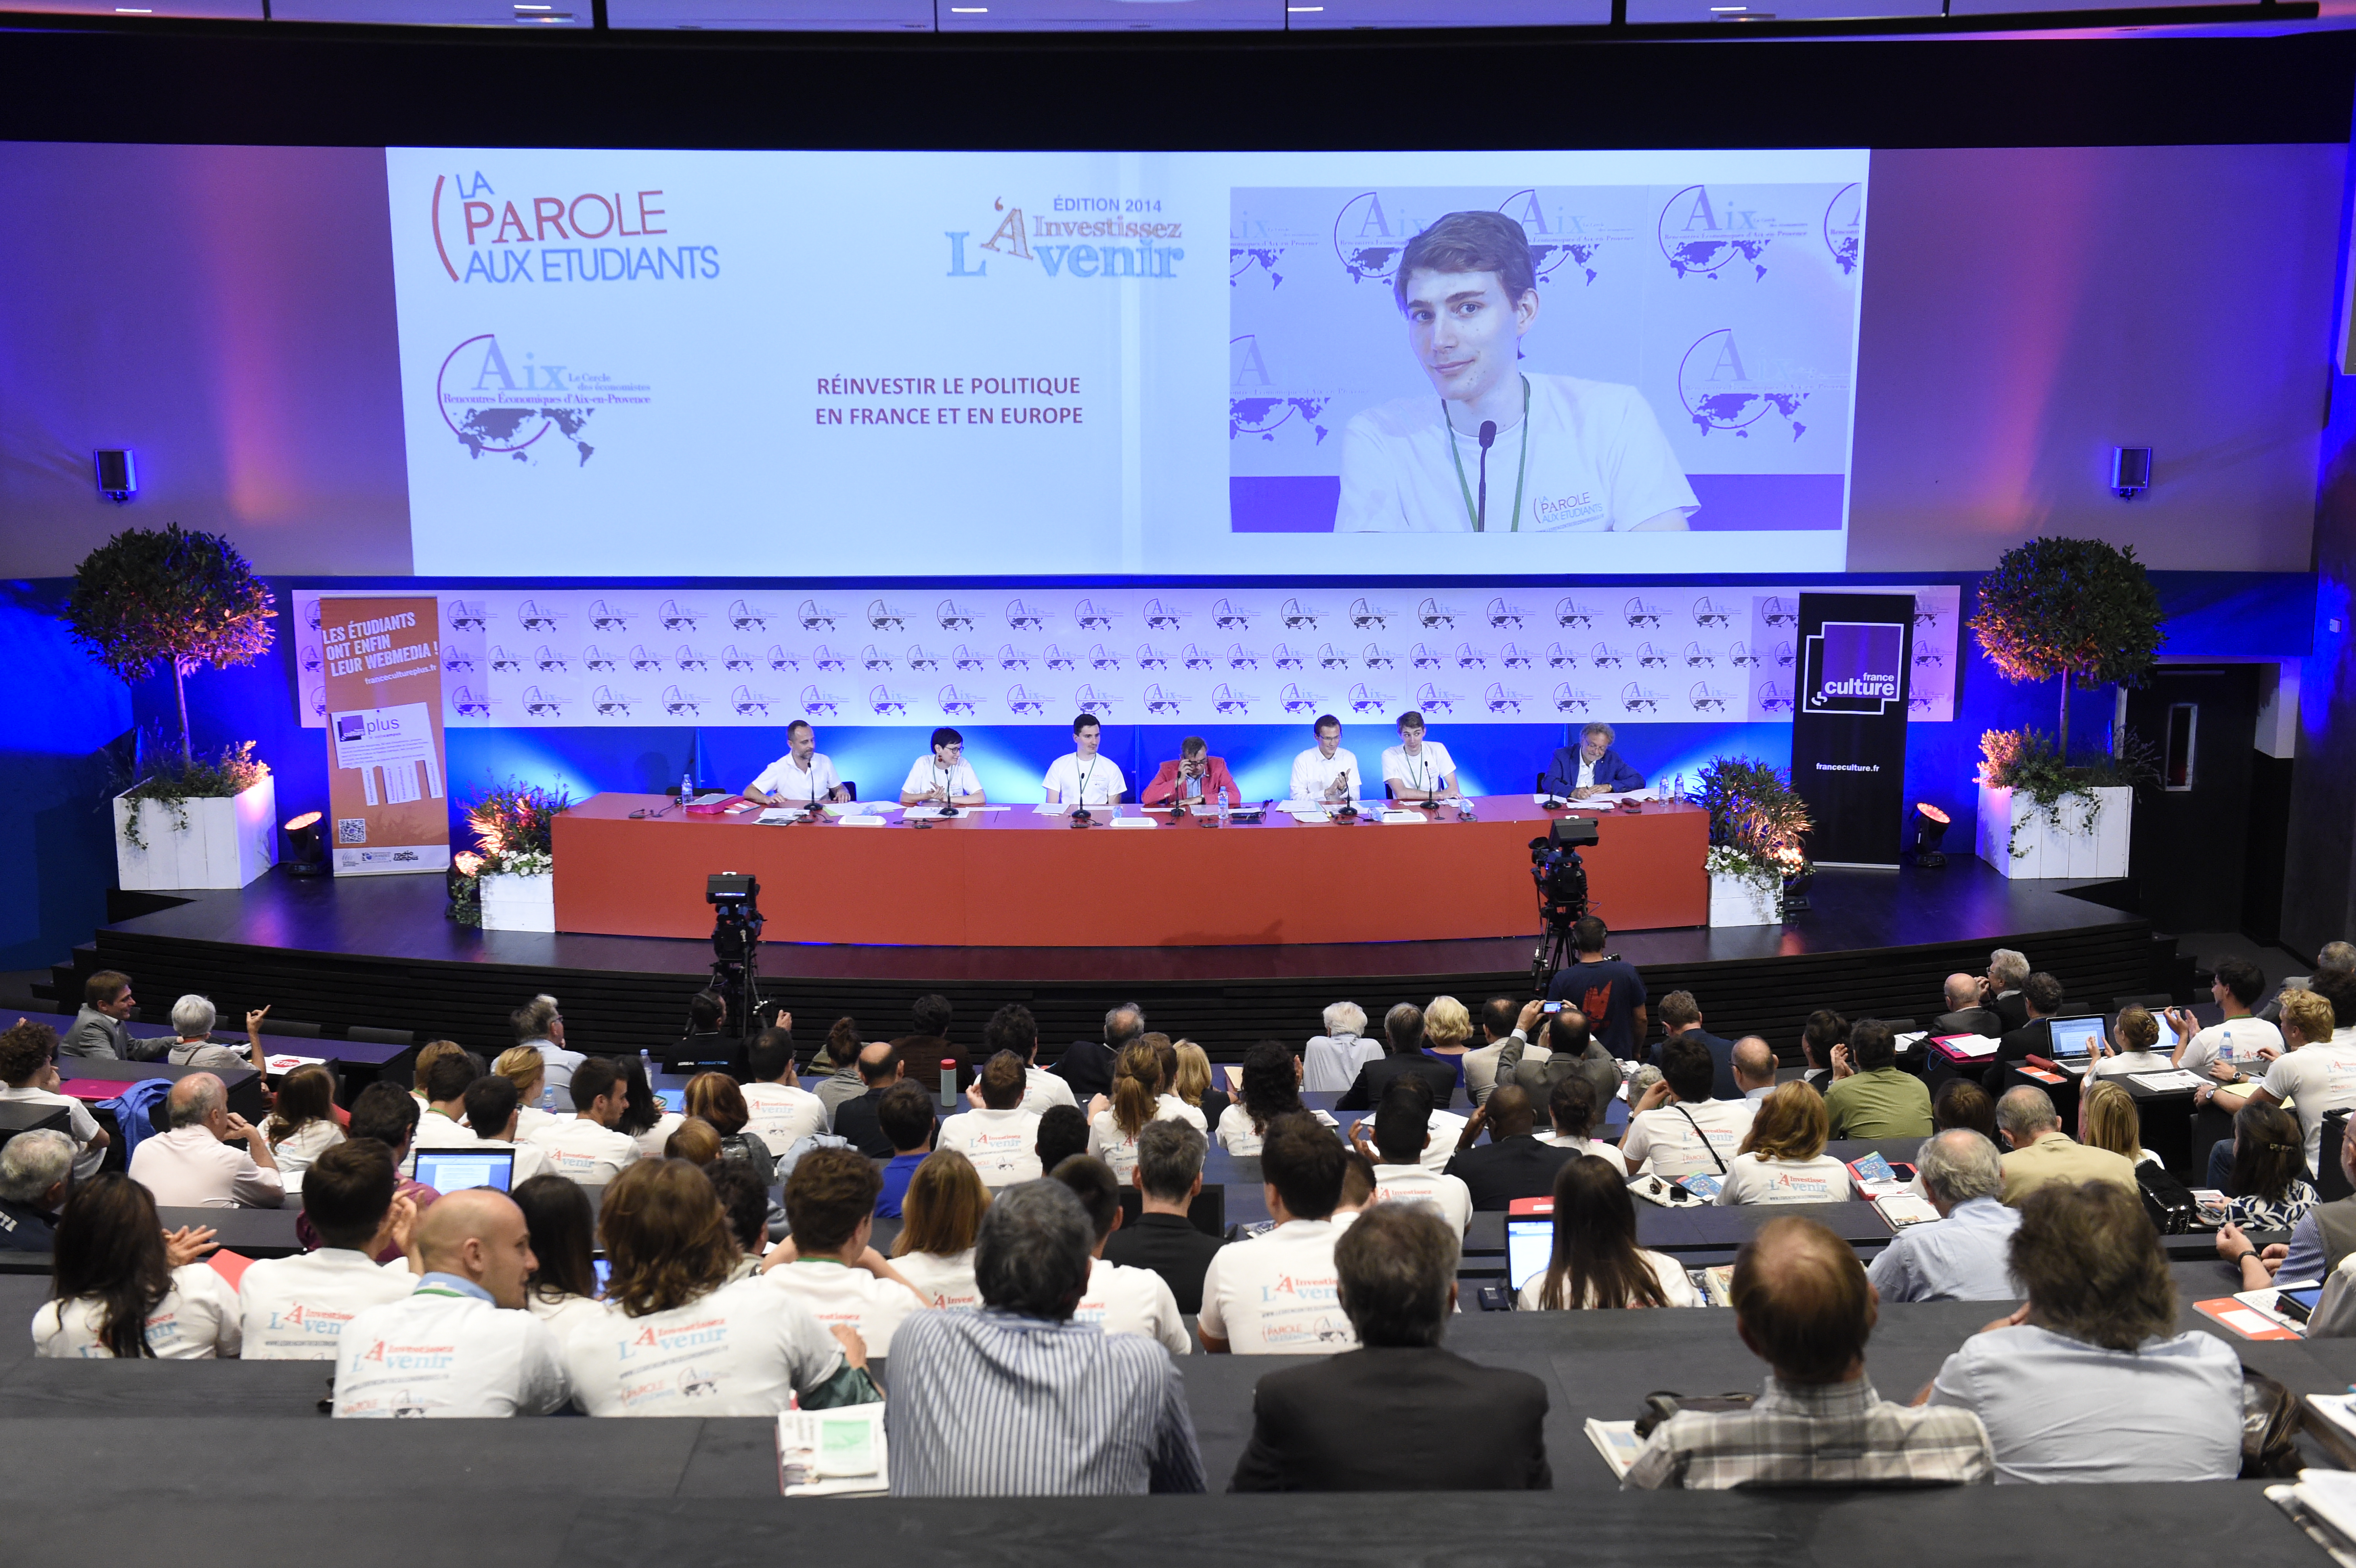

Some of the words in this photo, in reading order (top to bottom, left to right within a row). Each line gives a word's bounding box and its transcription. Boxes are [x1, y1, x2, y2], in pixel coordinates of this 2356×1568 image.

[456, 171, 494, 199] LA
[1054, 195, 1120, 211] ÉDITION
[1125, 199, 1162, 213] 2014
[1681, 185, 1757, 231] Aix
[464, 190, 667, 245] PAROLE
[1033, 215, 1182, 238] Investissez
[464, 249, 534, 283] AUX
[541, 246, 720, 282] ETUDIANTS
[471, 336, 569, 391] Aix
[568, 373, 580, 382] Le
[582, 373, 611, 382] Cercle
[817, 373, 936, 395] RÉINVESTIR
[944, 378, 963, 394] LE
[971, 377, 1080, 396] POLITIQUE
[444, 393, 495, 403] Rencontres
[498, 391, 562, 405] Économiques
[564, 393, 651, 404] d'Aix-en-Provence
[816, 408, 842, 425] EN
[850, 408, 930, 425] FRANCE
[938, 408, 960, 425] ET
[968, 408, 993, 425] EN
[1001, 407, 1083, 425] EUROPE
[1541, 492, 1591, 514] PAROLE
[1542, 513, 1559, 523] AUX
[1560, 503, 1603, 520] ETUDIANTS
[322, 626, 346, 644] LES
[348, 612, 416, 640] ÉTUDIANTS
[326, 642, 350, 661] ONT
[354, 634, 392, 655] ENFIN
[330, 658, 363, 677] LEUR
[364, 642, 432, 670] WEBMEDIA
[1824, 678, 1895, 696] culture
[1863, 672, 1895, 682] france
[367, 718, 400, 735] plus
[1816, 762, 1879, 772] franceculture.fr
[947, 1296, 974, 1306] Invest
[1267, 1323, 1302, 1336] PAROLE
[388, 1345, 455, 1354] Investissez
